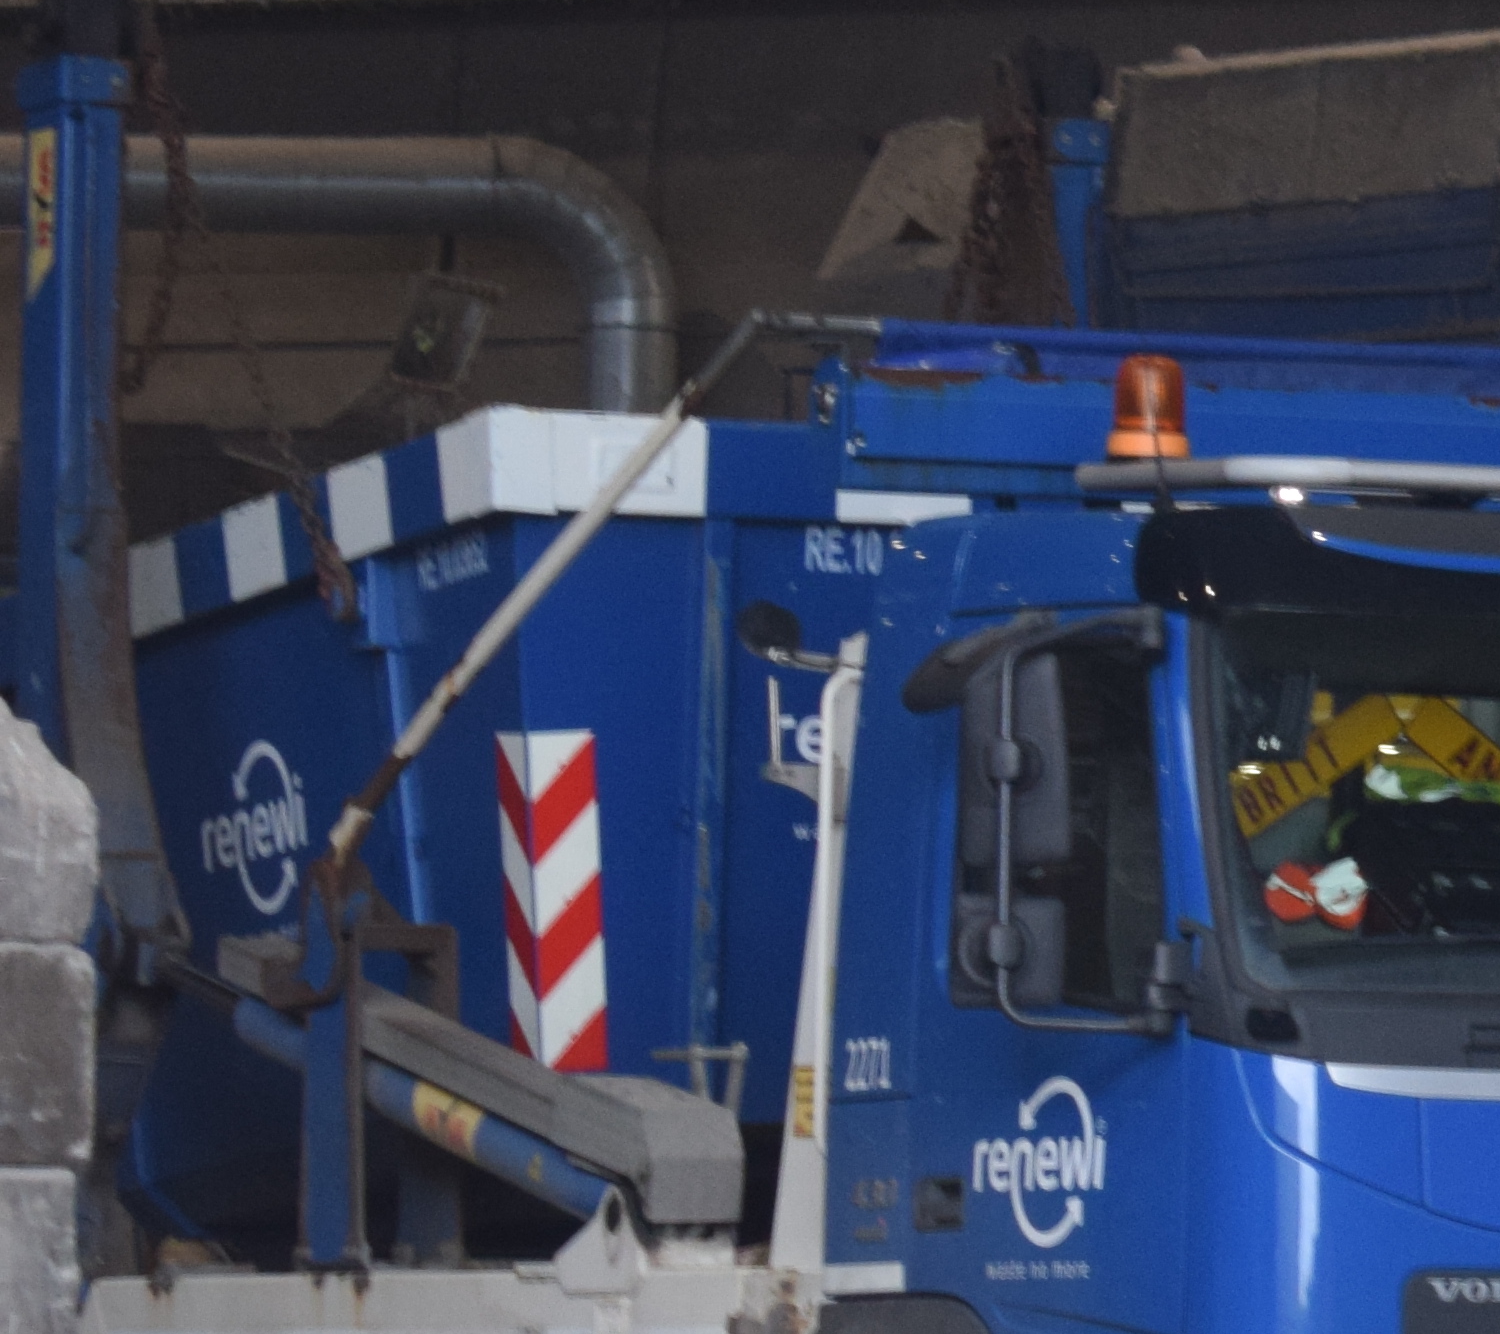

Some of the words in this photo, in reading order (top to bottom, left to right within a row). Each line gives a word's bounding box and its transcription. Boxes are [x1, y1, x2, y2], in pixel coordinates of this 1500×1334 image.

[201, 771, 310, 874] renewi
[843, 1035, 893, 1092] 2271
[972, 1115, 1108, 1194] renewi
